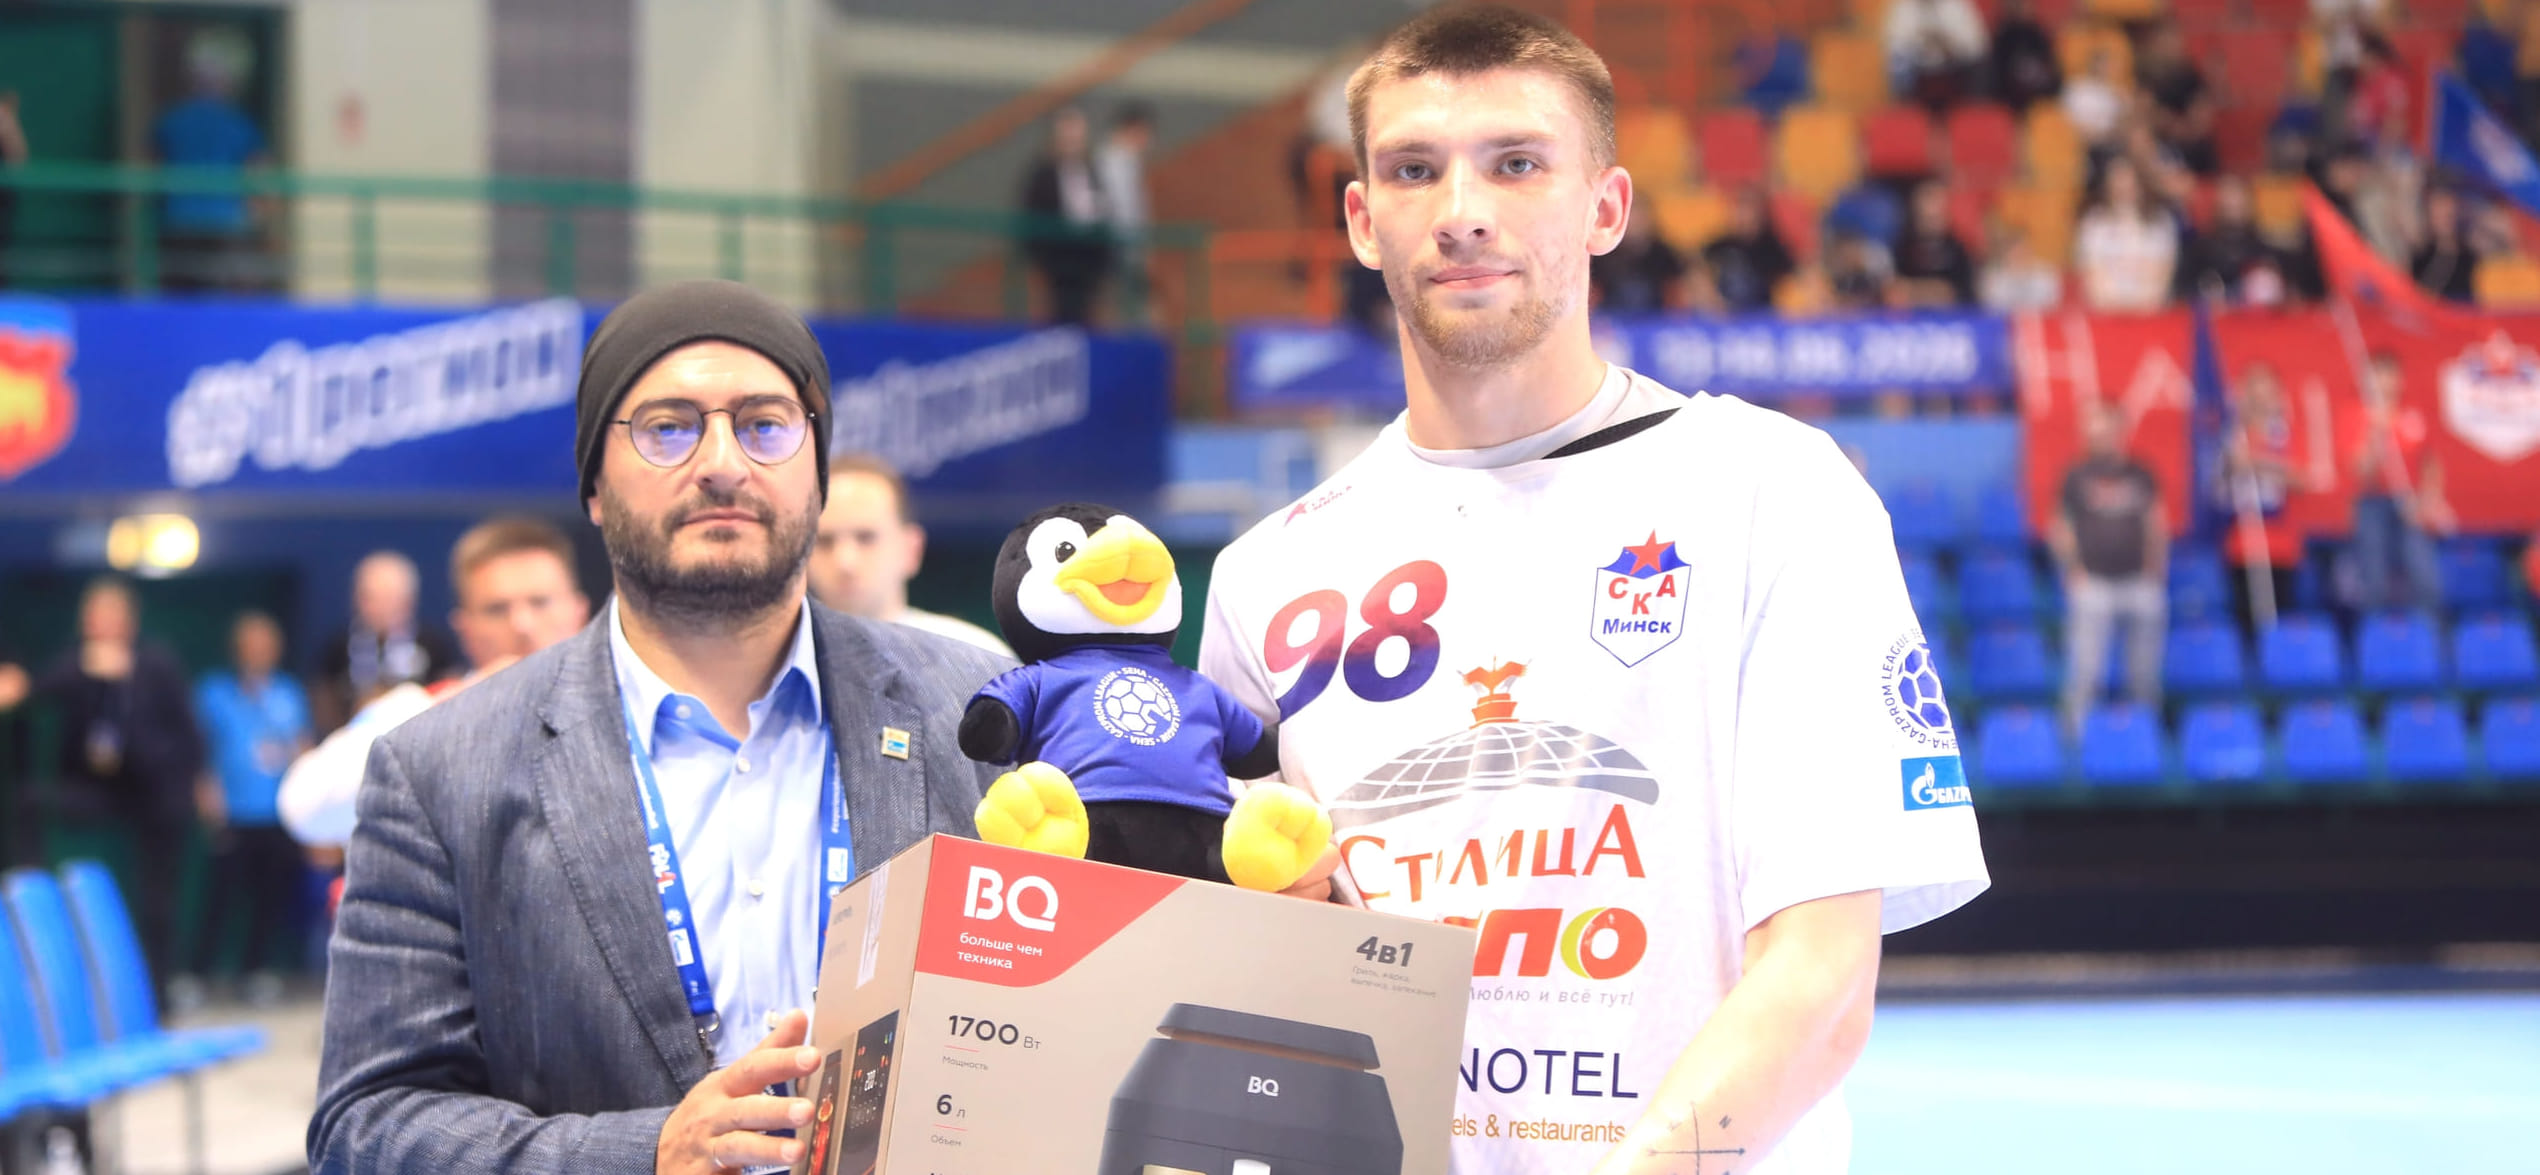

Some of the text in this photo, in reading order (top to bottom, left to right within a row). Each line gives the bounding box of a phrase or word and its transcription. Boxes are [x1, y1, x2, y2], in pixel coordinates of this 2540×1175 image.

[1603, 618, 1672, 635] Минск
[1264, 560, 1448, 722] 98
[963, 866, 1059, 932] BQ
[959, 932, 1043, 957] больше чем
[1356, 936, 1413, 967] 4в1
[957, 951, 1013, 969] техника
[1539, 991, 1550, 1001] и
[1558, 988, 1591, 1004] всё
[1600, 991, 1634, 1008] тут!
[949, 1015, 1042, 1050] 1700 Вт
[942, 1055, 989, 1071] Мощность
[1247, 1076, 1279, 1097] BQ
[936, 1094, 966, 1119] 6 л
[1485, 1114, 1500, 1138] &
[1508, 1117, 1627, 1144] restaurants
